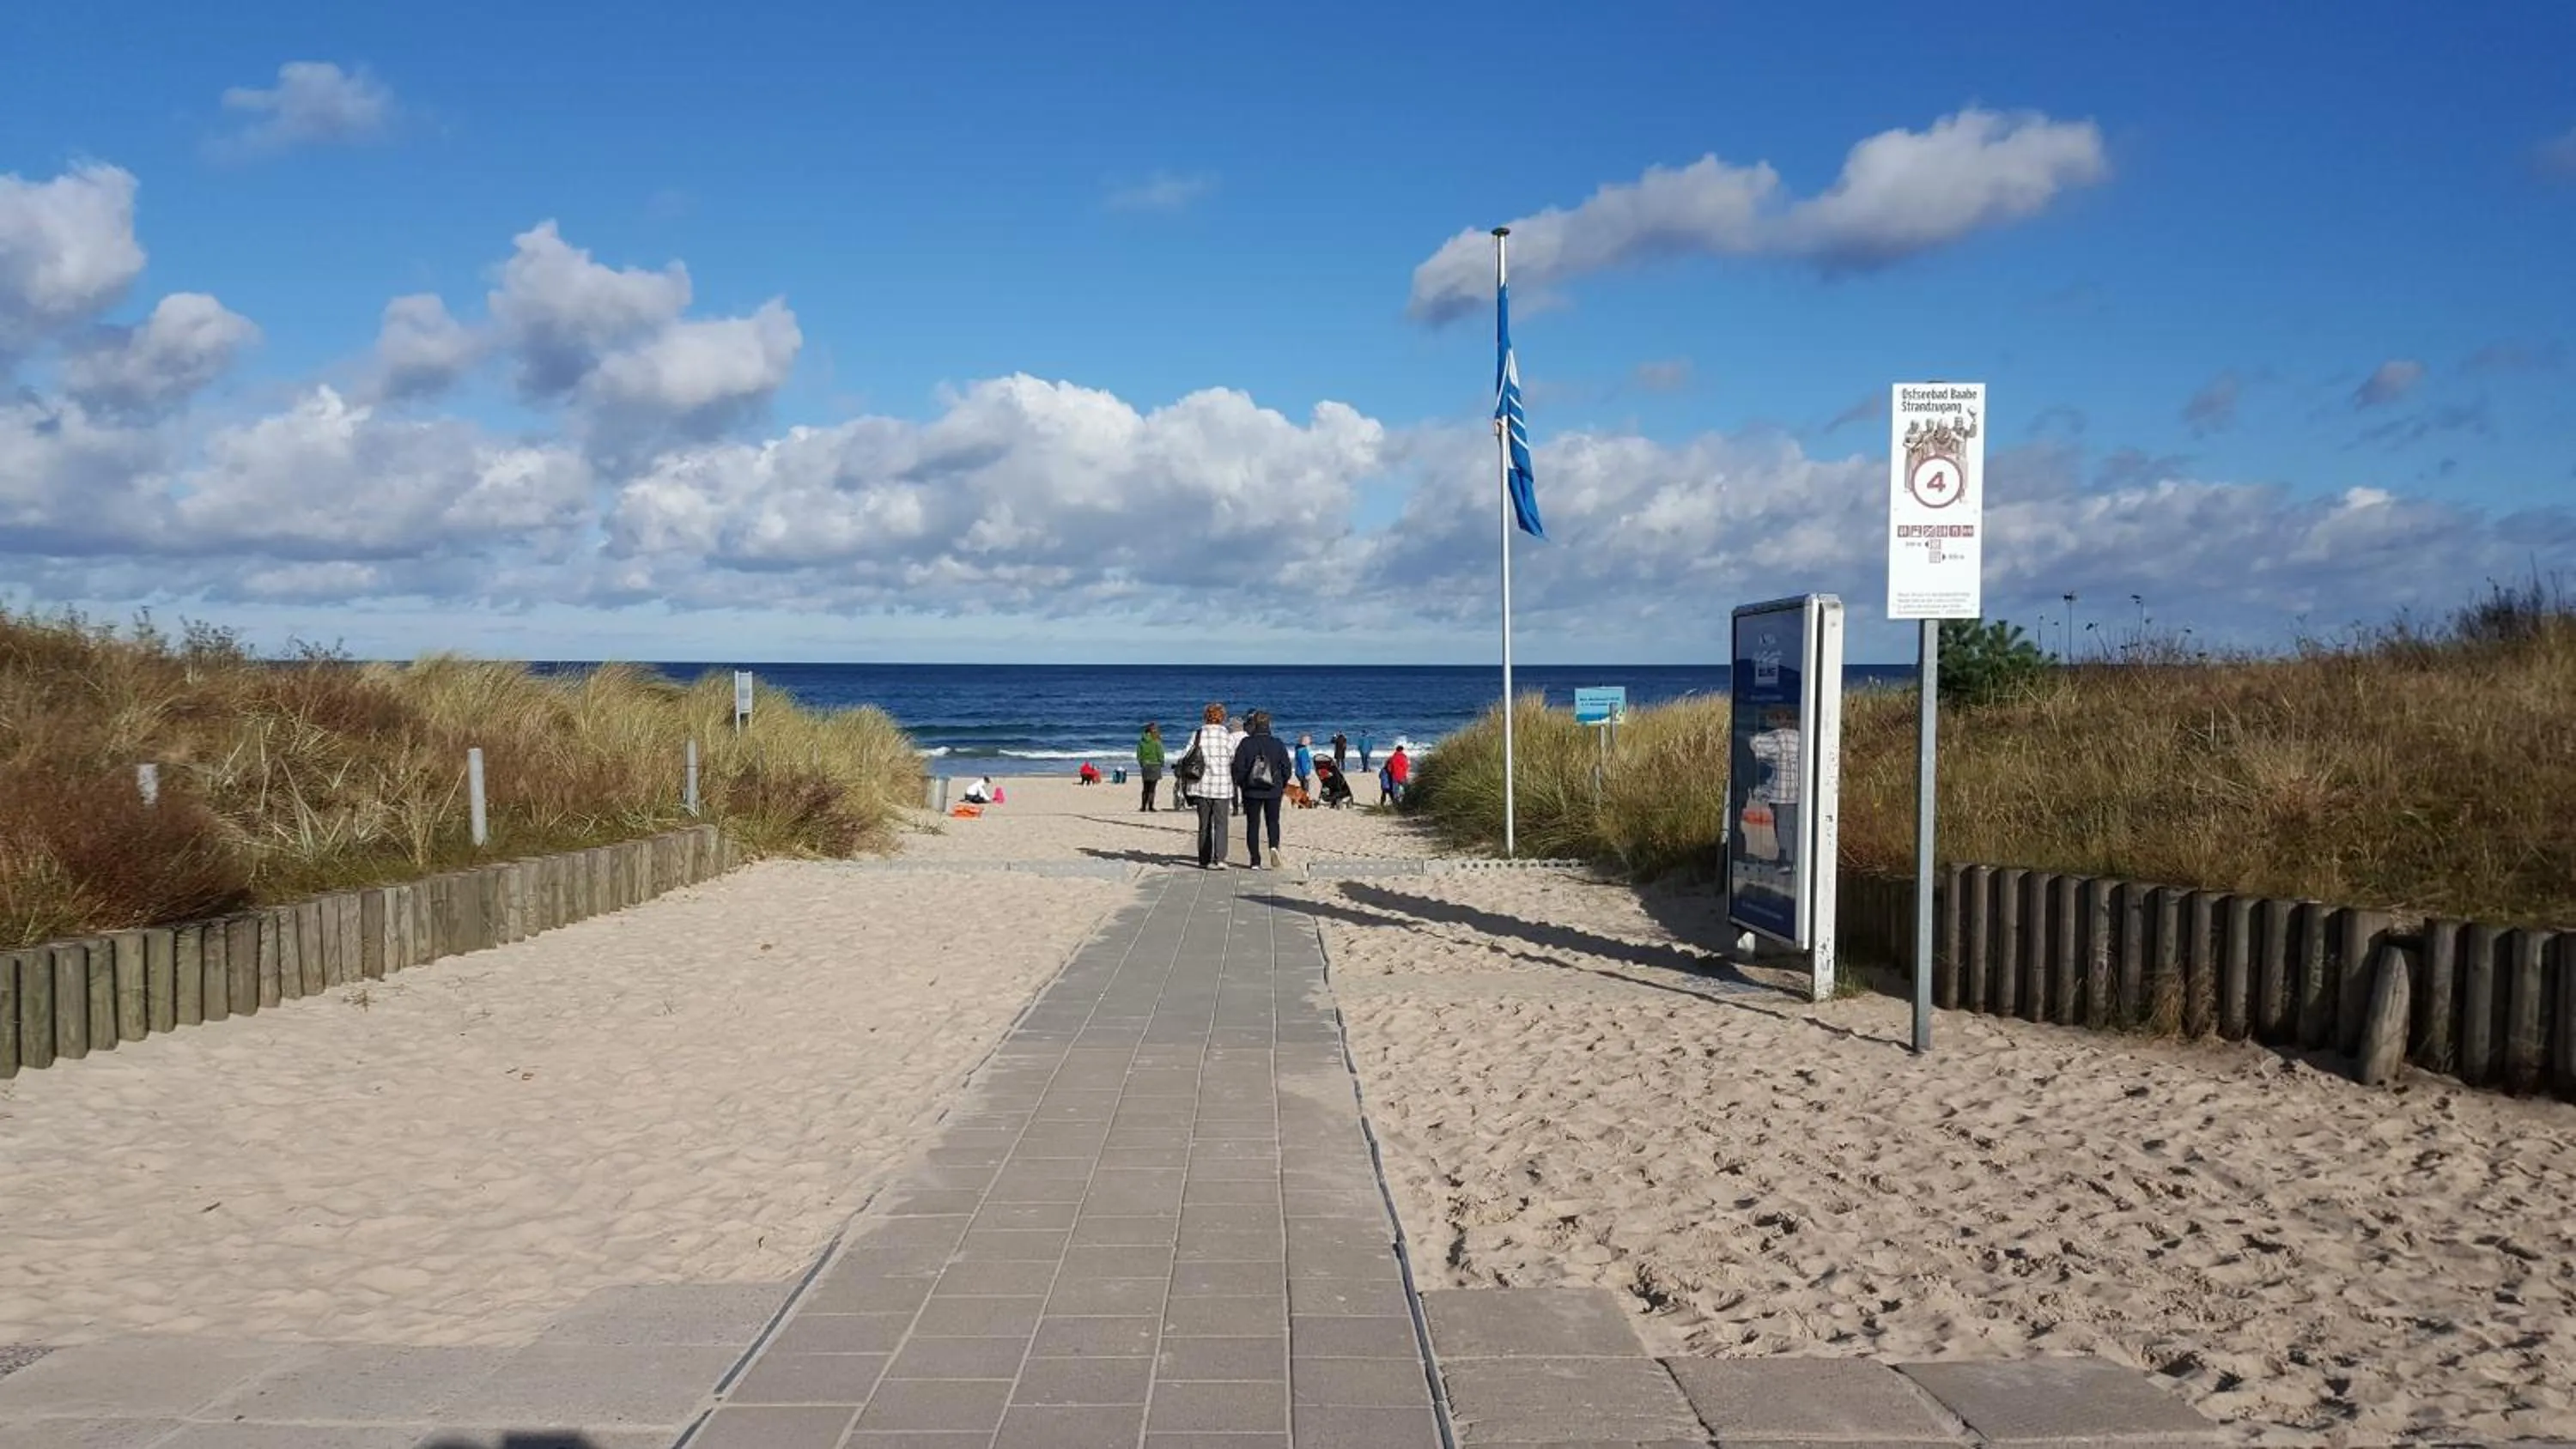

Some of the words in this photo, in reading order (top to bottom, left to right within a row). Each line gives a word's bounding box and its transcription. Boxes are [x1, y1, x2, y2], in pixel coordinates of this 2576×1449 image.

[1902, 388, 1948, 399] Ostseebad
[1950, 388, 1978, 399] Baabe
[1901, 401, 1962, 414] Strandzugang
[1927, 471, 1946, 493] 4
